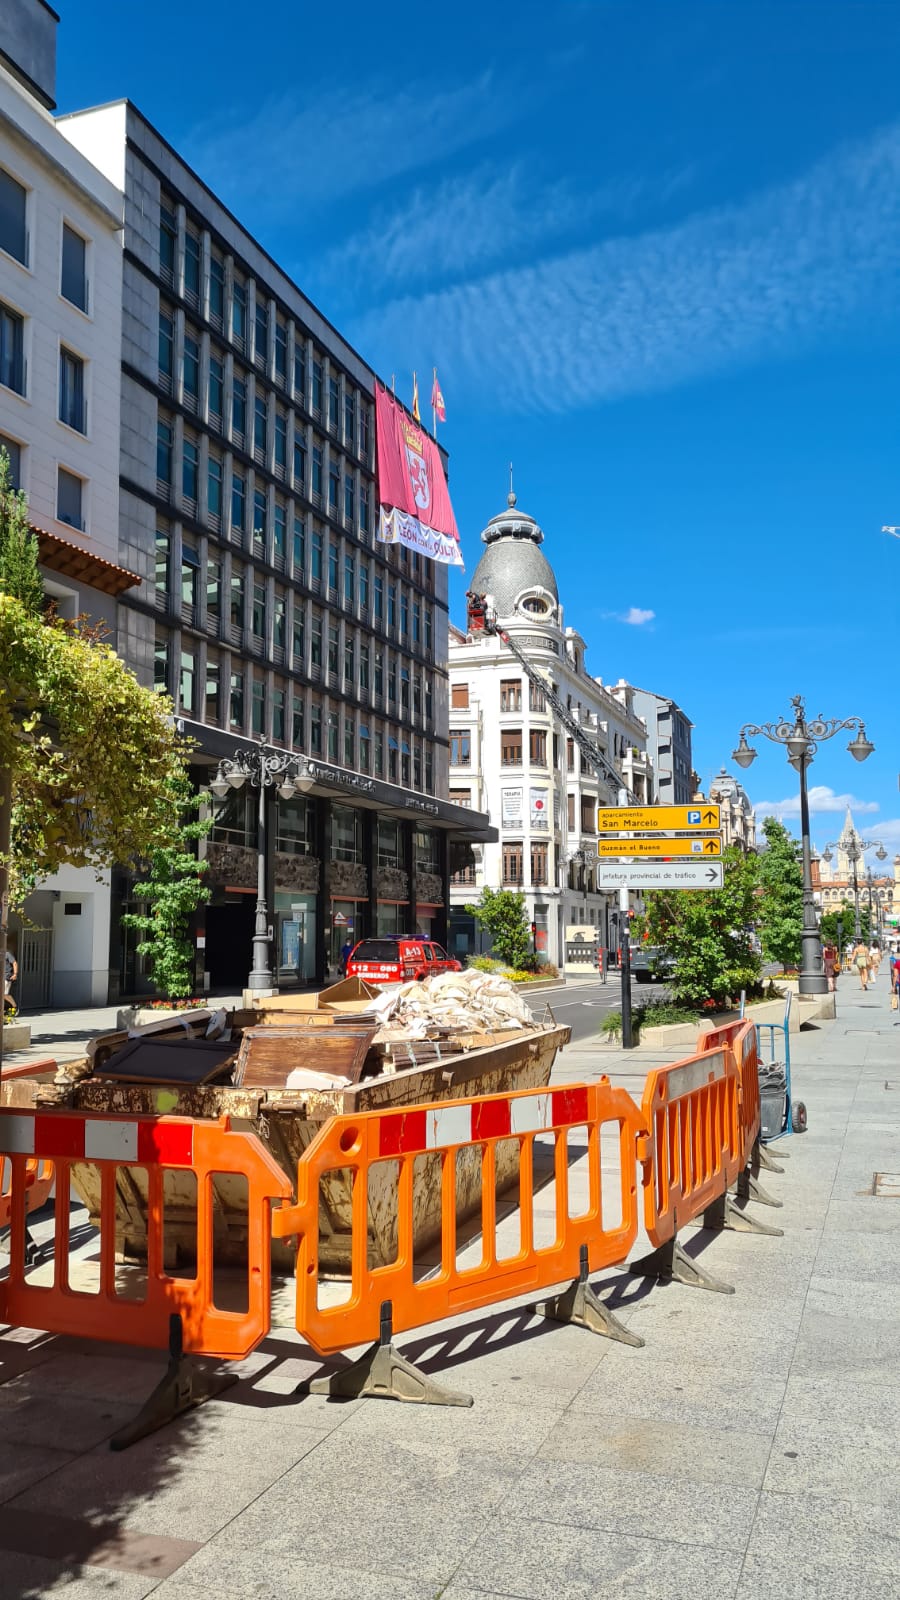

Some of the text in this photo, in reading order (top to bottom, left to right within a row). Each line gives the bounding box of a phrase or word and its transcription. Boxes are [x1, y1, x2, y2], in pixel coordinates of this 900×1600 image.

[623, 819, 658, 827] Marcelo
[602, 872, 627, 880] jefatura
[630, 872, 661, 880] provincial
[405, 947, 421, 956] A-13
[352, 964, 368, 972] 112
